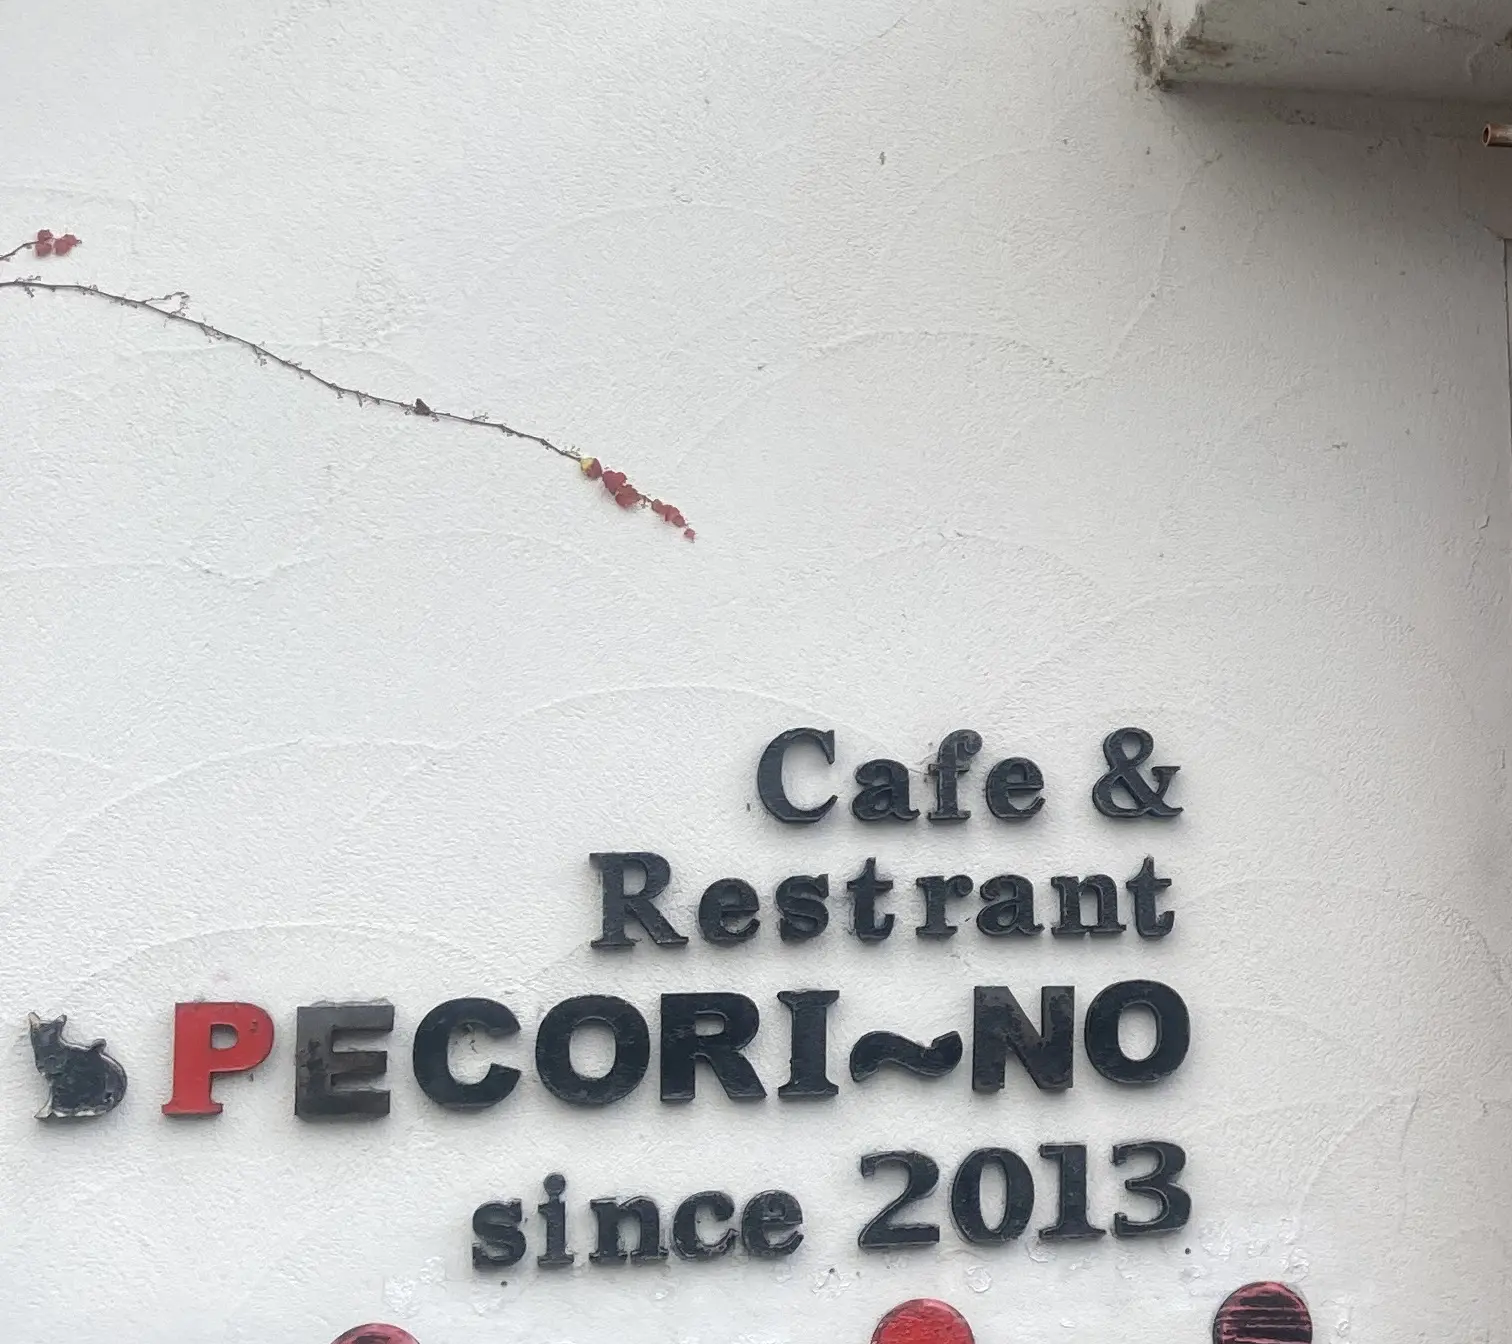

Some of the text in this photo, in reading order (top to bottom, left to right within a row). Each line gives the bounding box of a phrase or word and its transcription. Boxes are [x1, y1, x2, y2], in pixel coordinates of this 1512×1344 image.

[757, 725, 1185, 825] Cafe &
[589, 852, 1177, 950] Restrant
[471, 1140, 1193, 1270] since 2013
